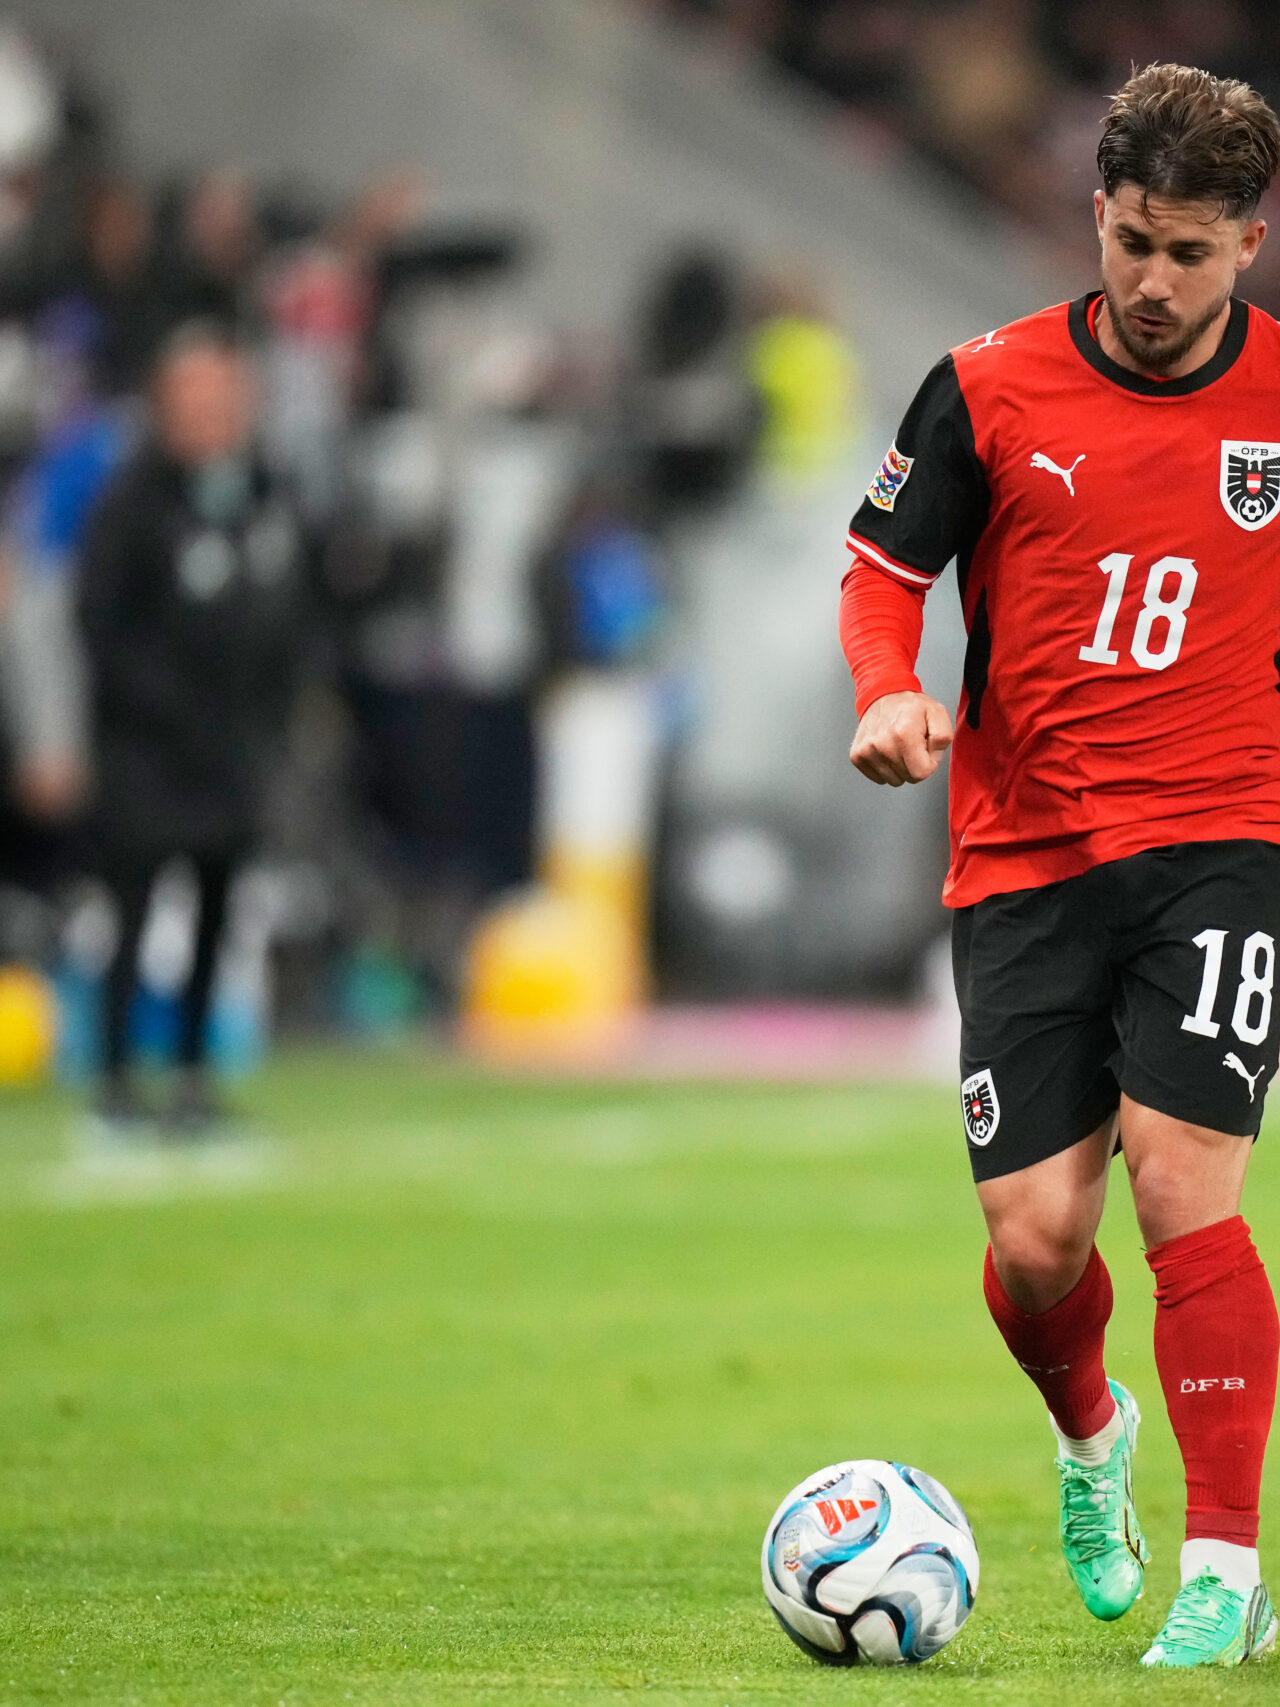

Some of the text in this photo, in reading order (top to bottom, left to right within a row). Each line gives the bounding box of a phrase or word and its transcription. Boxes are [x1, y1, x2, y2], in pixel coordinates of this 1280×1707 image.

[1241, 445, 1269, 457] ÖFB
[1078, 552, 1199, 671] 18
[1180, 928, 1276, 1046] 18
[1180, 1377, 1246, 1394] ÖFB
